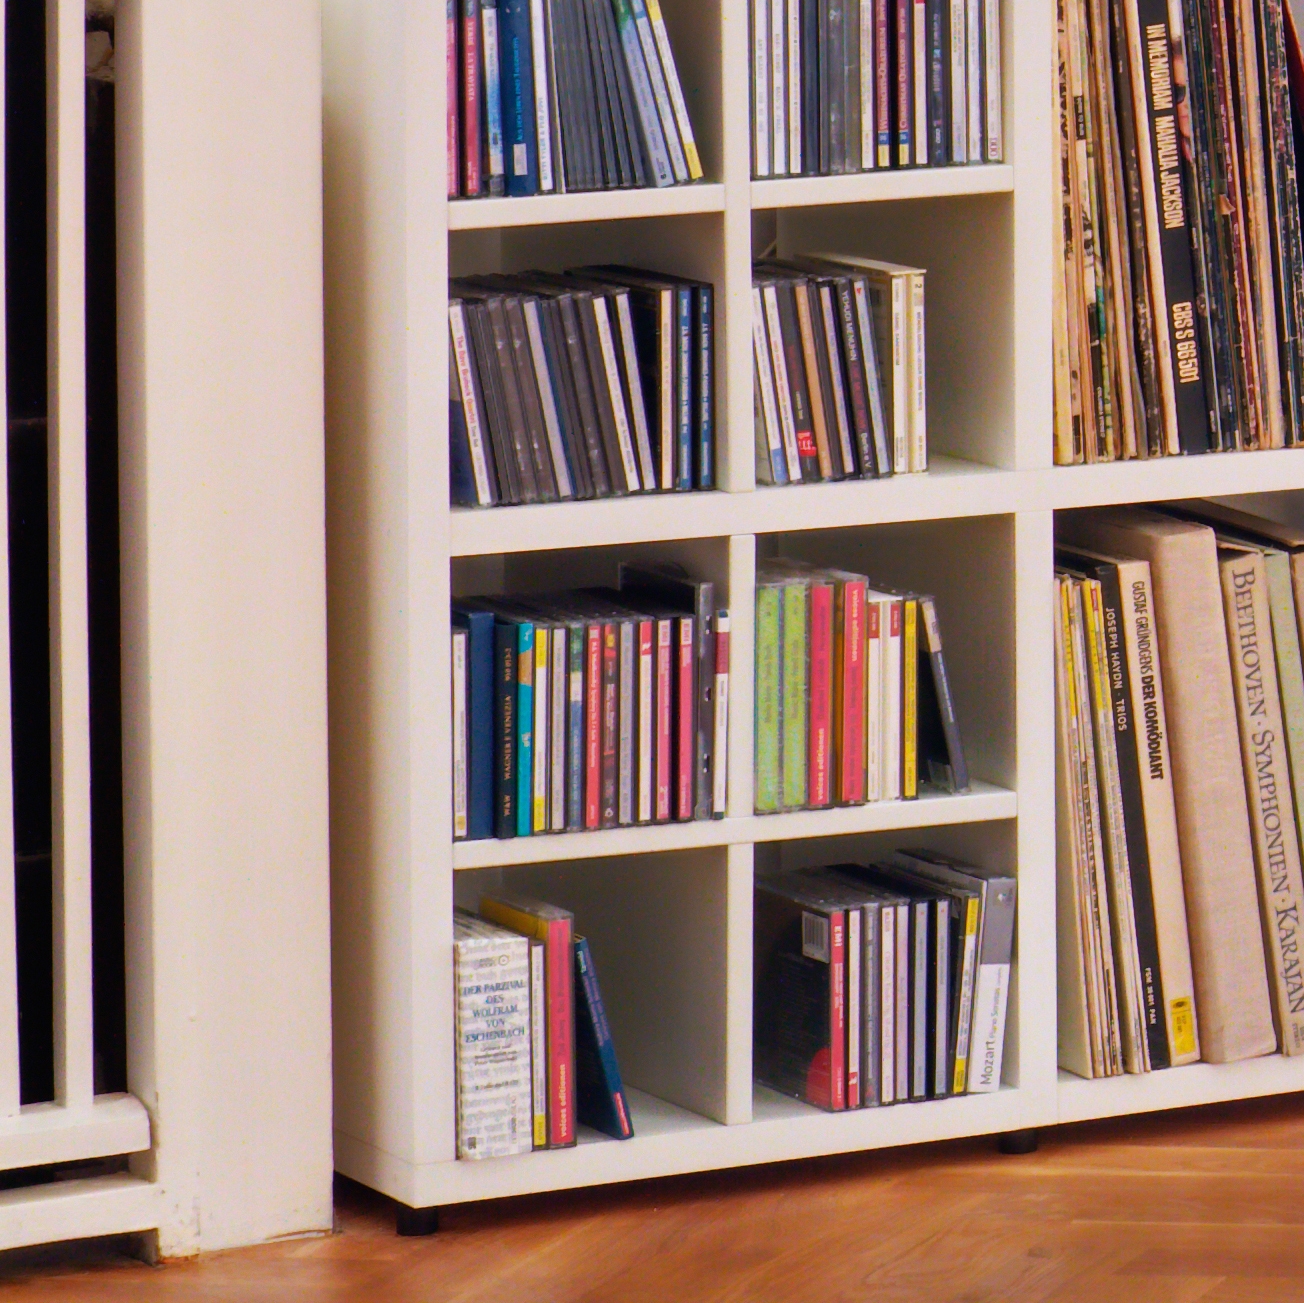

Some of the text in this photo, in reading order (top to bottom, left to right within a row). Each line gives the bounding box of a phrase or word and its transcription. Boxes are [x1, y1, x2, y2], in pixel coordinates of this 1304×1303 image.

[1146, 23, 1185, 229] IN MEMORIAM MAHALIA JACKSON
[841, 290, 854, 322] YEHUDI
[846, 322, 857, 361] MENUHIN
[1172, 302, 1200, 383] CBS S 66501
[457, 336, 465, 349] The
[466, 398, 476, 424] Quartet
[860, 432, 870, 454] Berlin
[851, 589, 860, 618] voices
[851, 620, 860, 661] editionen
[1105, 608, 1127, 731] JOSEPH HAYDN TRIOS
[1131, 581, 1164, 780] GUSTAF GRÜNDGENS DER KOMÖDIANT
[817, 728, 825, 770] editionen
[1231, 567, 1267, 718] BEETHOVEN
[1251, 729, 1291, 895] SYMPHONIEN
[834, 926, 842, 947] EMI
[463, 980, 526, 995] DER PARZIVAL
[485, 994, 504, 1005] DES
[472, 1005, 518, 1018] WOLFRAM
[485, 1018, 506, 1029] VON
[465, 1027, 525, 1043] ESCHENBACH
[980, 1041, 995, 1085] Mozart
[559, 1064, 568, 1138] voices editionen
